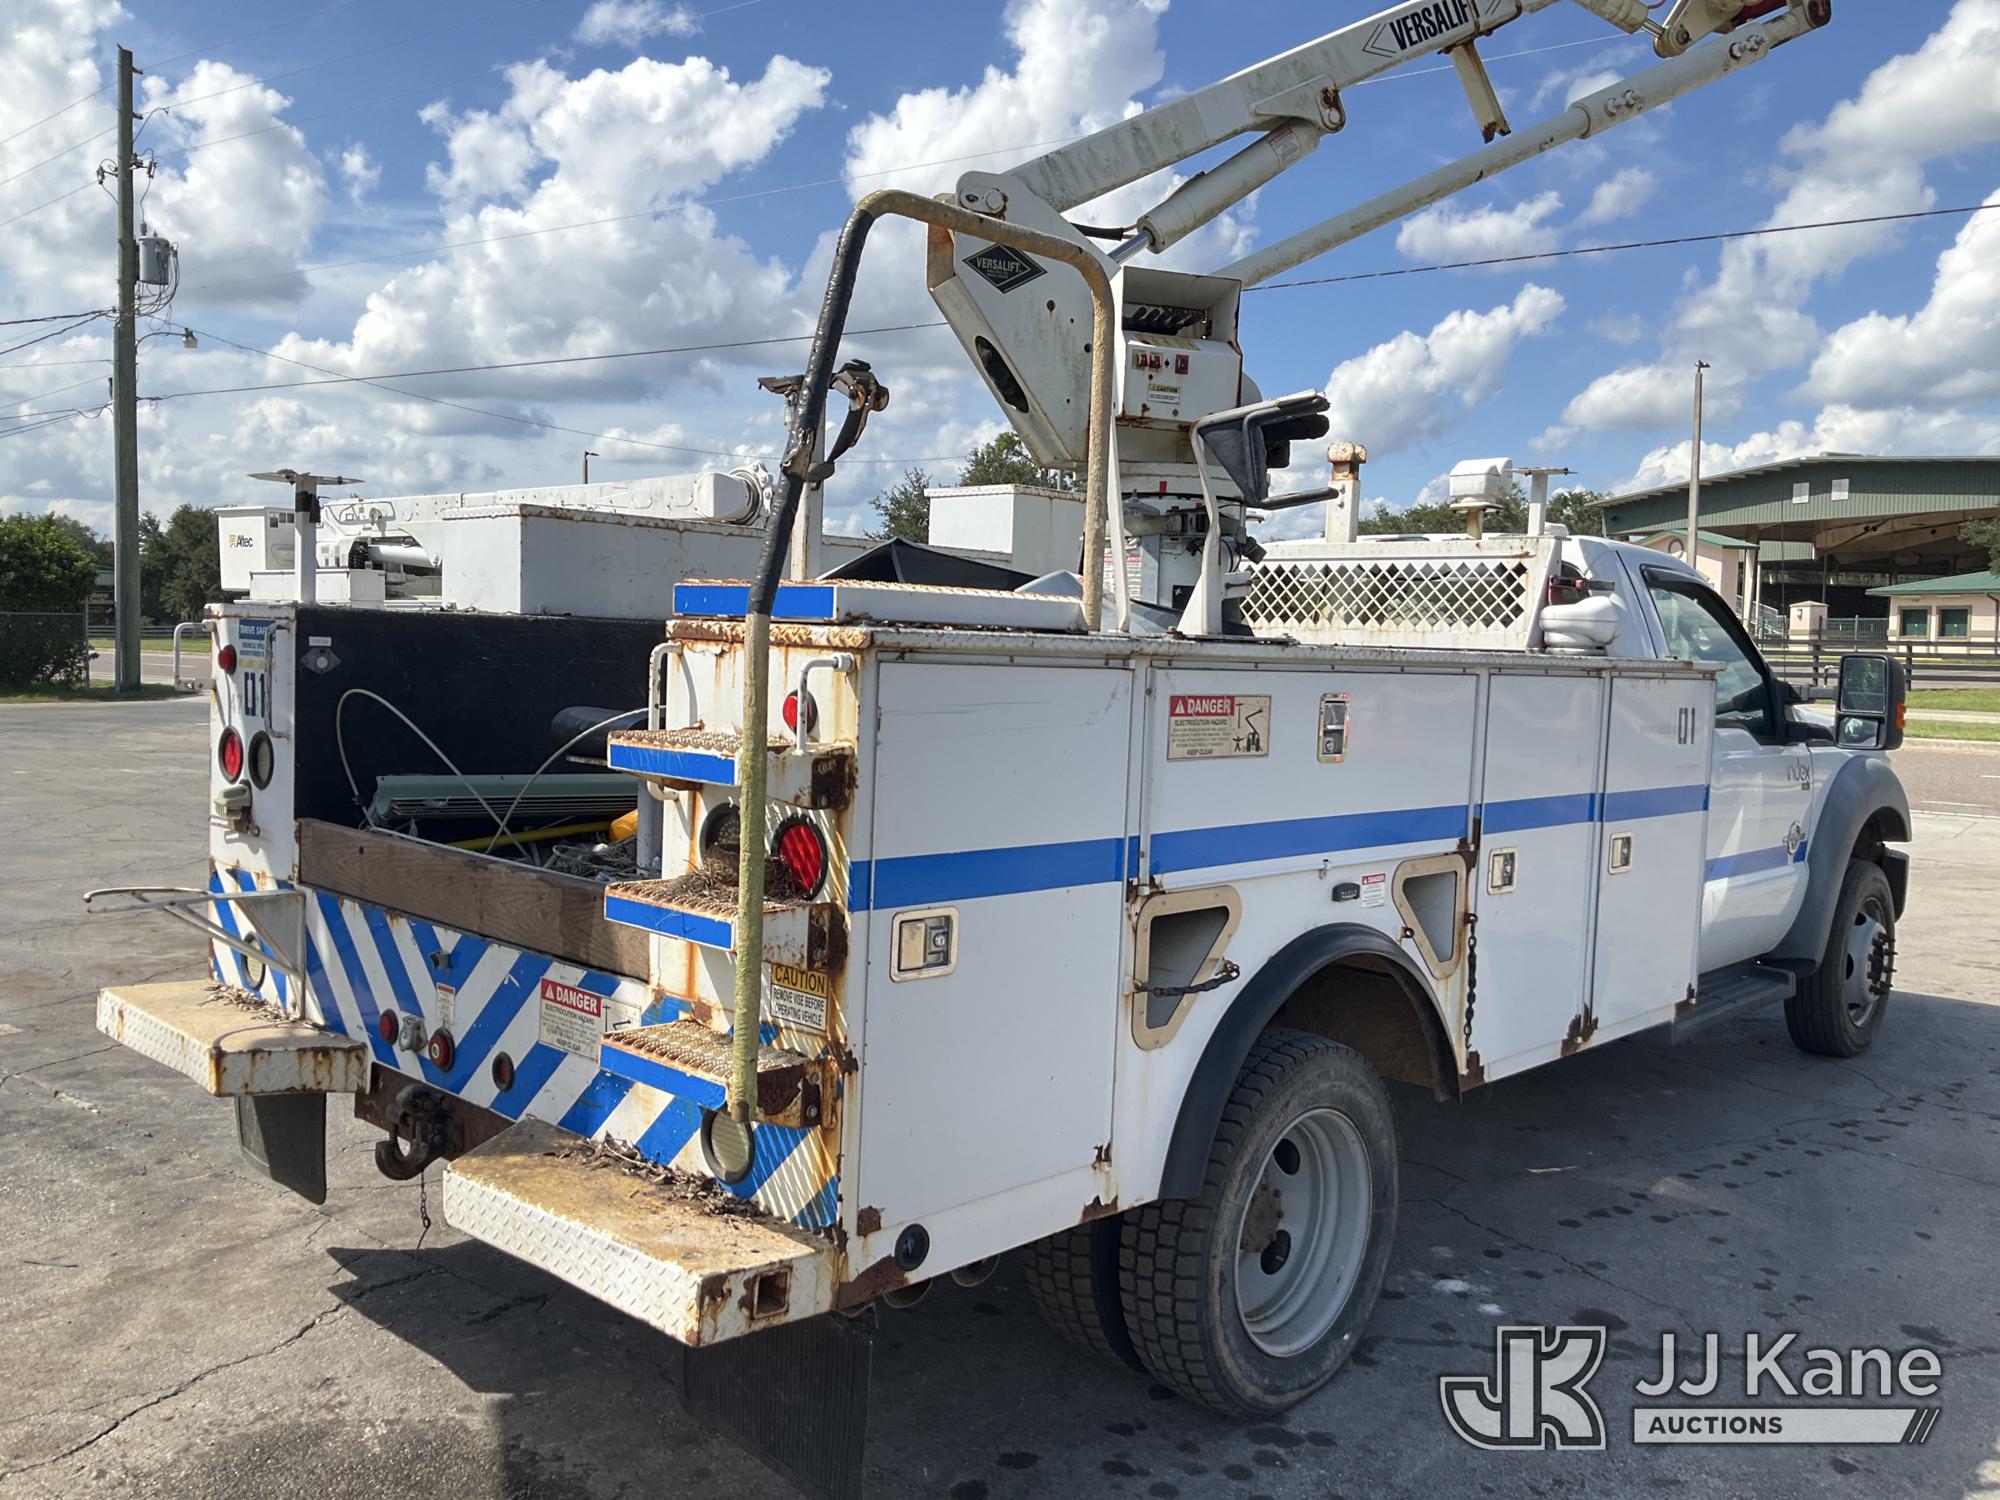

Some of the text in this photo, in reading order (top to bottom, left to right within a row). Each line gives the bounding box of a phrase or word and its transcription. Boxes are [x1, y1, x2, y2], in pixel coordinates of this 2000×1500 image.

[976, 257, 1020, 273] VERSALIFT
[236, 535, 253, 548] Altec
[1187, 699, 1231, 714] DANGER
[775, 965, 825, 994] CAUTION
[556, 986, 598, 1014] DANGER
[773, 988, 793, 1003] REMOVE
[804, 995, 824, 1012] BEFORE
[802, 1009, 822, 1026] VEHICLE
